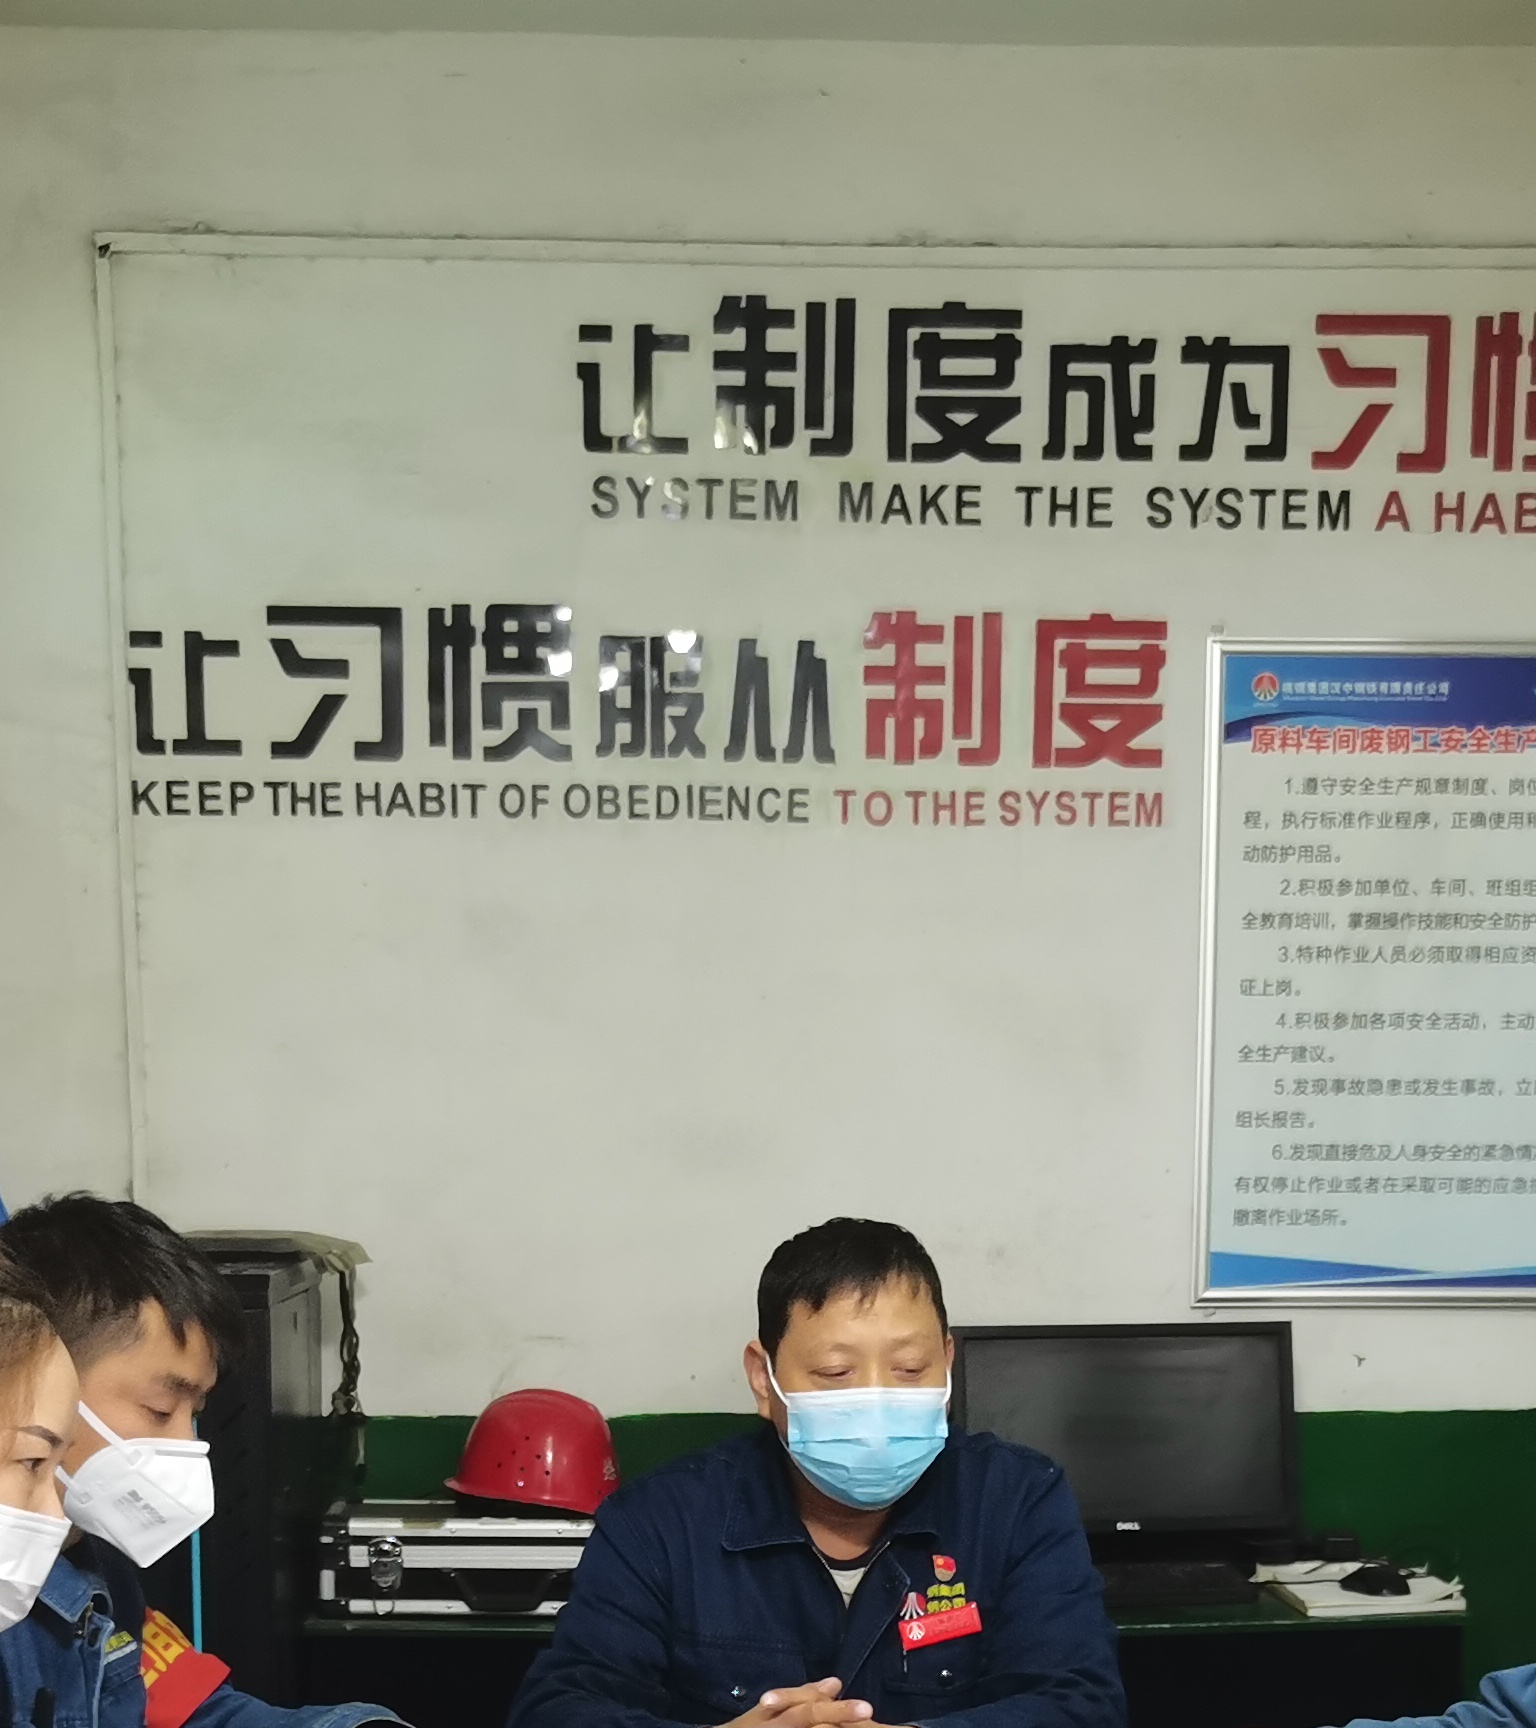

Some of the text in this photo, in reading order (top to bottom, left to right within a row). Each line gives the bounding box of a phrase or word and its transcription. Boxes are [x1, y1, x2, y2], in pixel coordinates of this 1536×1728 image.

[590, 474, 799, 522] SYSTEM
[838, 480, 982, 527] MAKE
[1015, 485, 1113, 529] THE
[1146, 485, 1352, 532] SYSTEM
[1375, 490, 1410, 533] A
[127, 603, 1168, 770] 让习惯服从制度
[130, 779, 1164, 828] KEEP THE HABIT OF OBEDIENCE TO THE SYSTEM
[1242, 844, 1343, 864] 动防护用品。
[1240, 978, 1303, 997] 证上岗。
[1237, 1045, 1336, 1065] 全生产建议。
[1235, 1110, 1317, 1130] 组长报告。
